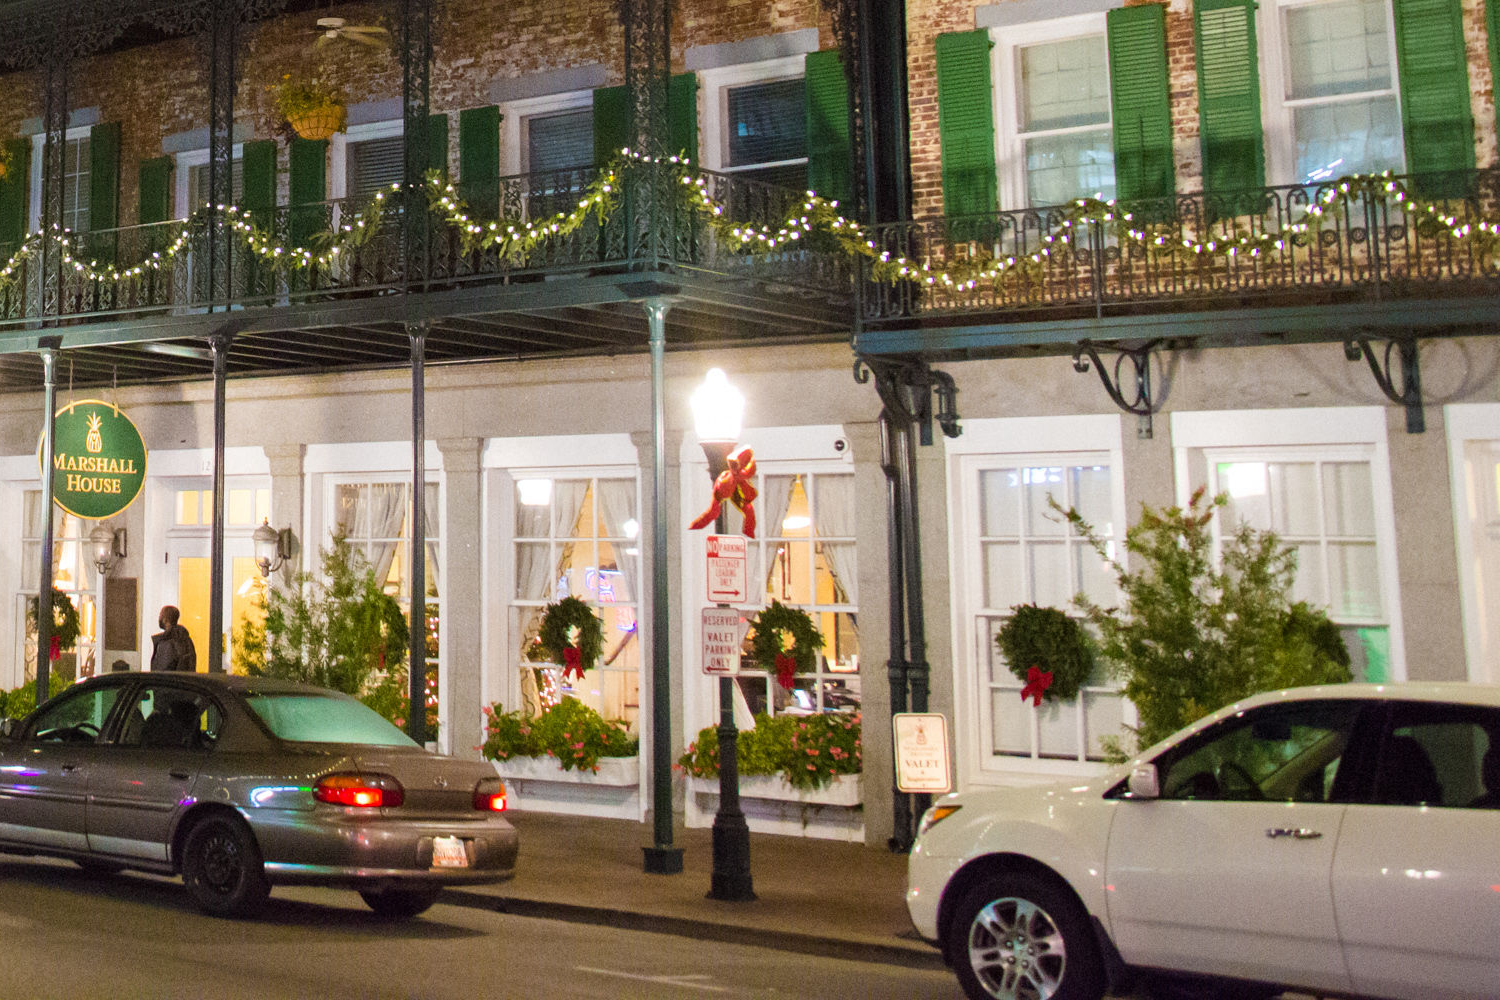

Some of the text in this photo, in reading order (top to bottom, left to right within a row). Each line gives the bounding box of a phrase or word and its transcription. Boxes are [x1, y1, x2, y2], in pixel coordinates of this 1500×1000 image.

[53, 453, 138, 475] MARSHALL
[66, 474, 122, 494] HOUSE
[708, 541, 745, 553] NO PARKING
[719, 578, 733, 586] ONLY
[703, 615, 739, 626] RESERVED
[707, 632, 733, 642] VALET
[705, 644, 737, 655] PARKING
[710, 657, 731, 667] ONLY
[905, 759, 939, 768] VALET
